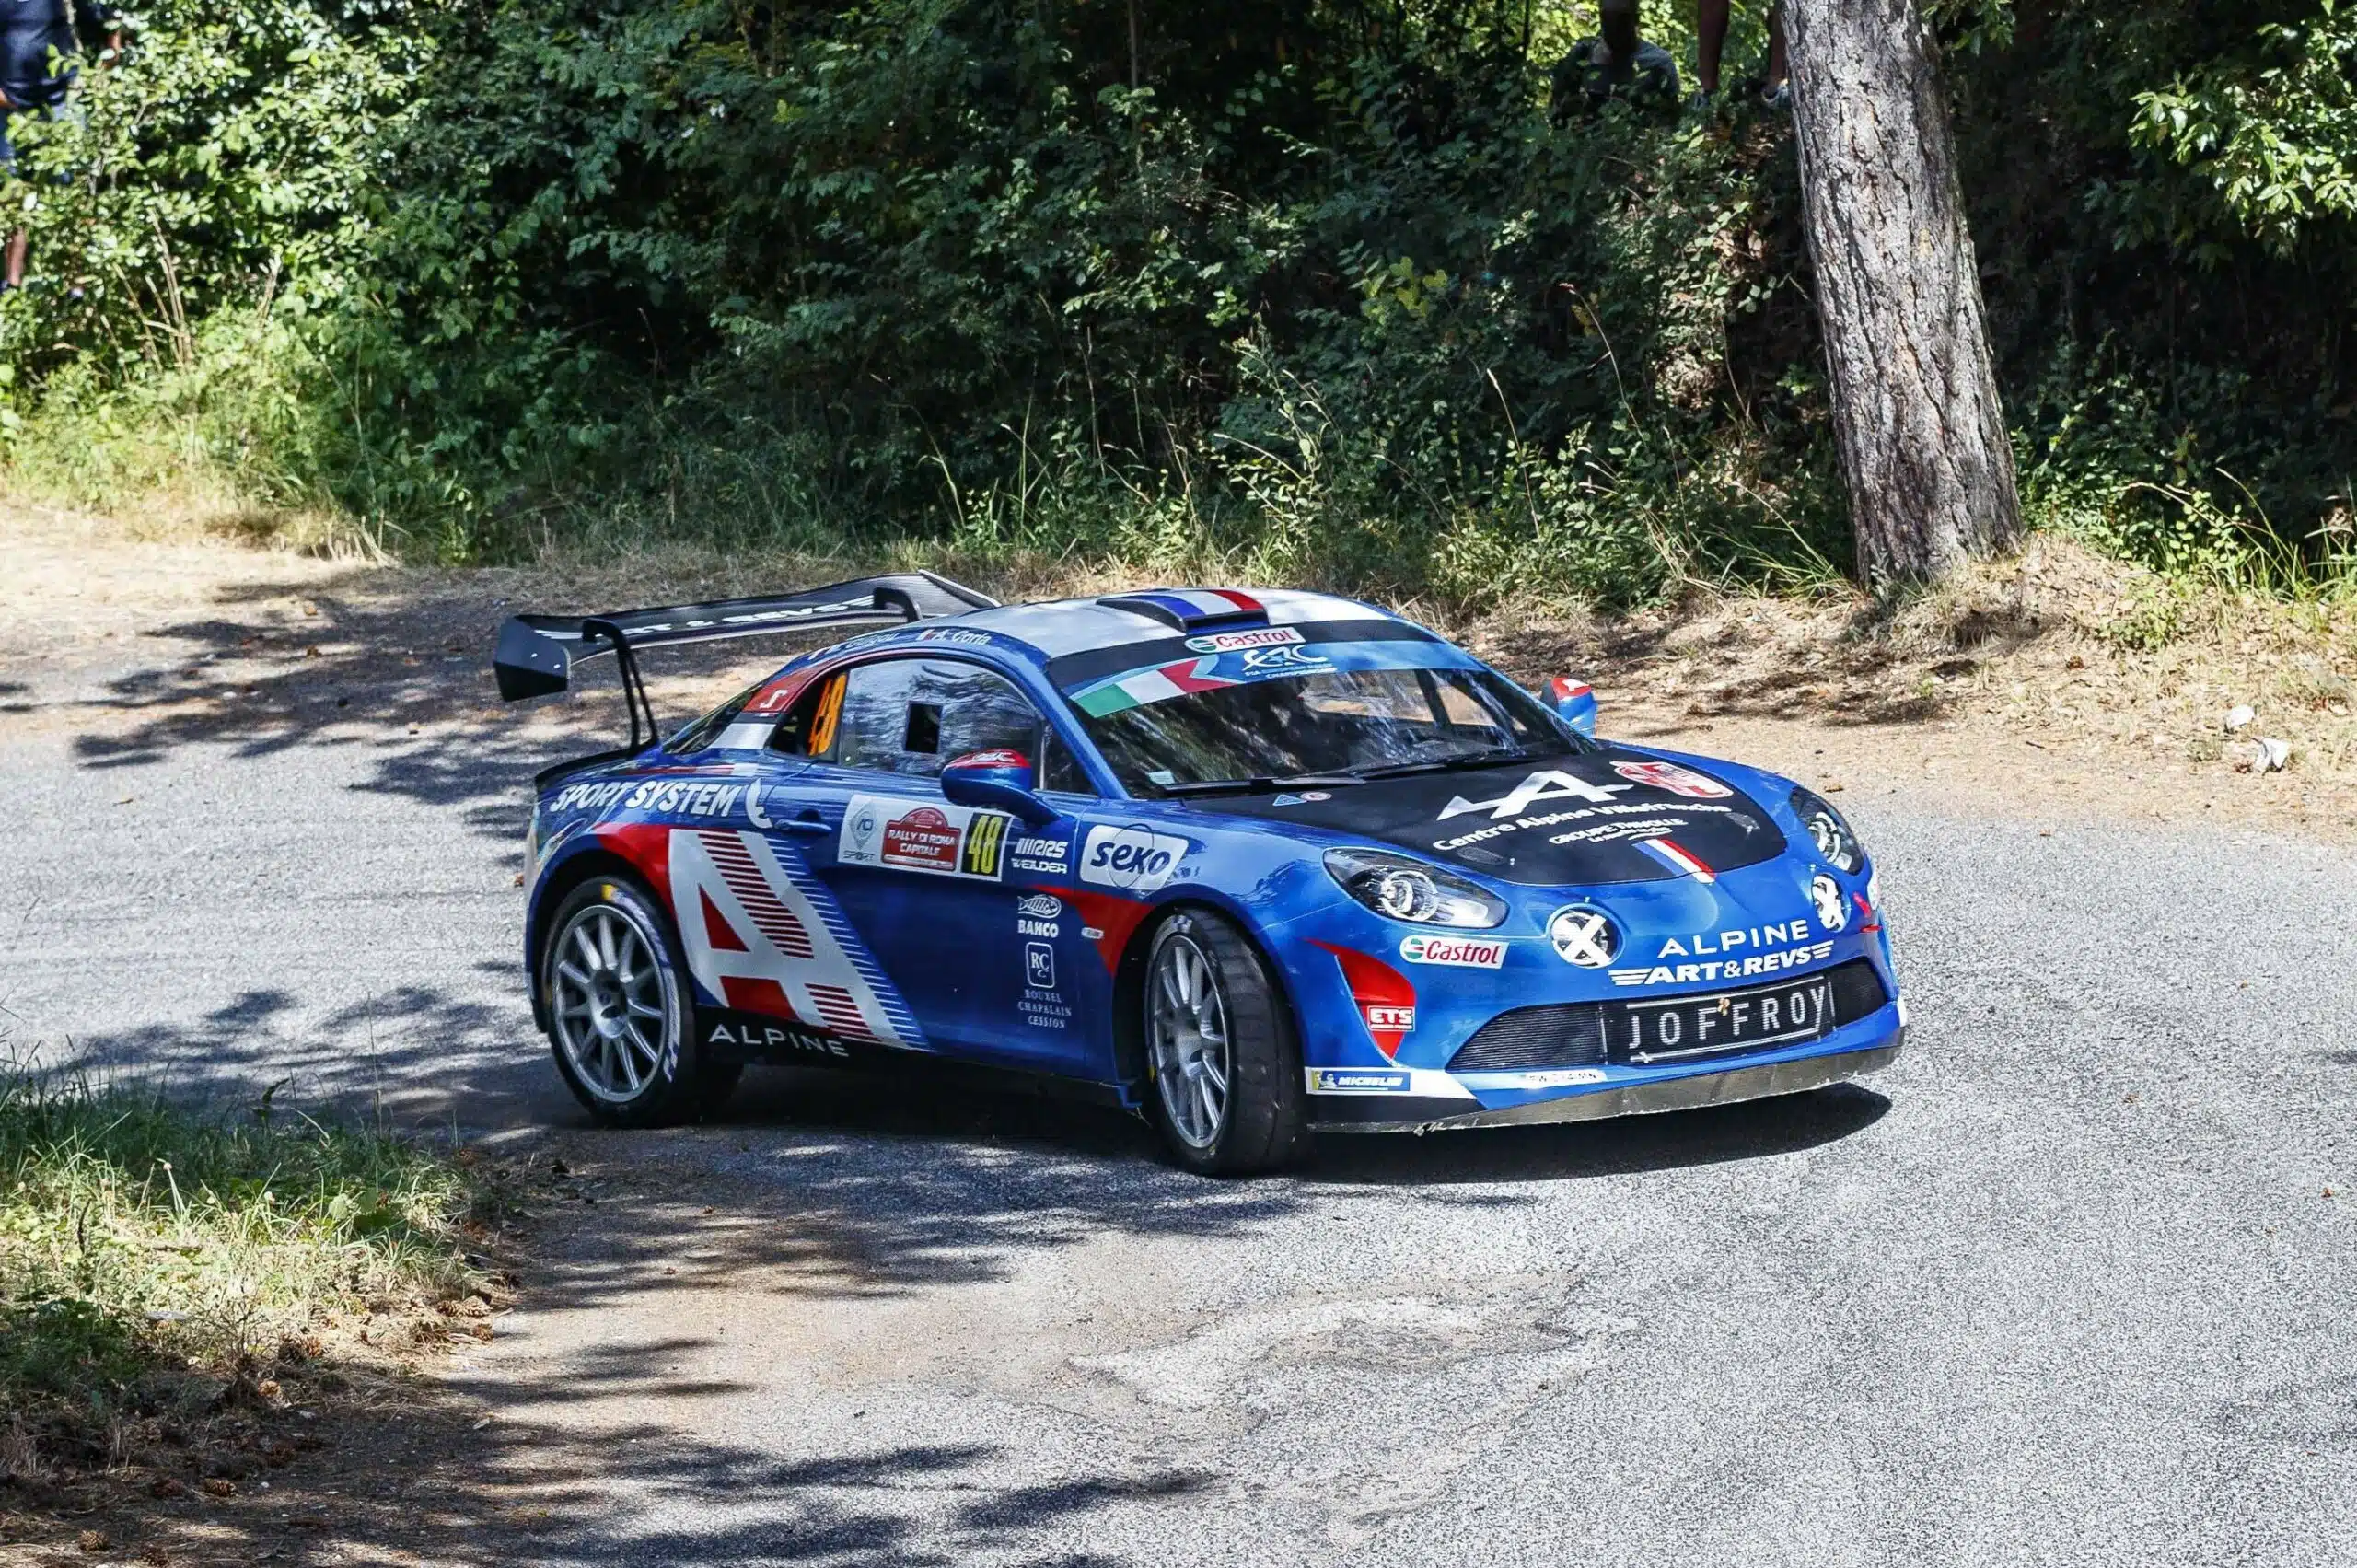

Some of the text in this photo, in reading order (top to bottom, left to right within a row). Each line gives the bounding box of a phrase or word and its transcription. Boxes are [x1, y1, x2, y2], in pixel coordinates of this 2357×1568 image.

[1215, 630, 1294, 648] Castrol
[549, 780, 743, 817] SPORT SYSTEM
[969, 815, 1004, 874] 48
[1017, 919, 1059, 938] BAHCO
[1657, 919, 1810, 958] ALPINE
[1426, 940, 1499, 965] Castrol
[1643, 947, 1812, 985] ART&REVS
[1370, 1008, 1414, 1024] ETS
[1628, 985, 1826, 1049] JOFFROY
[708, 1023, 850, 1057] ALPINE
